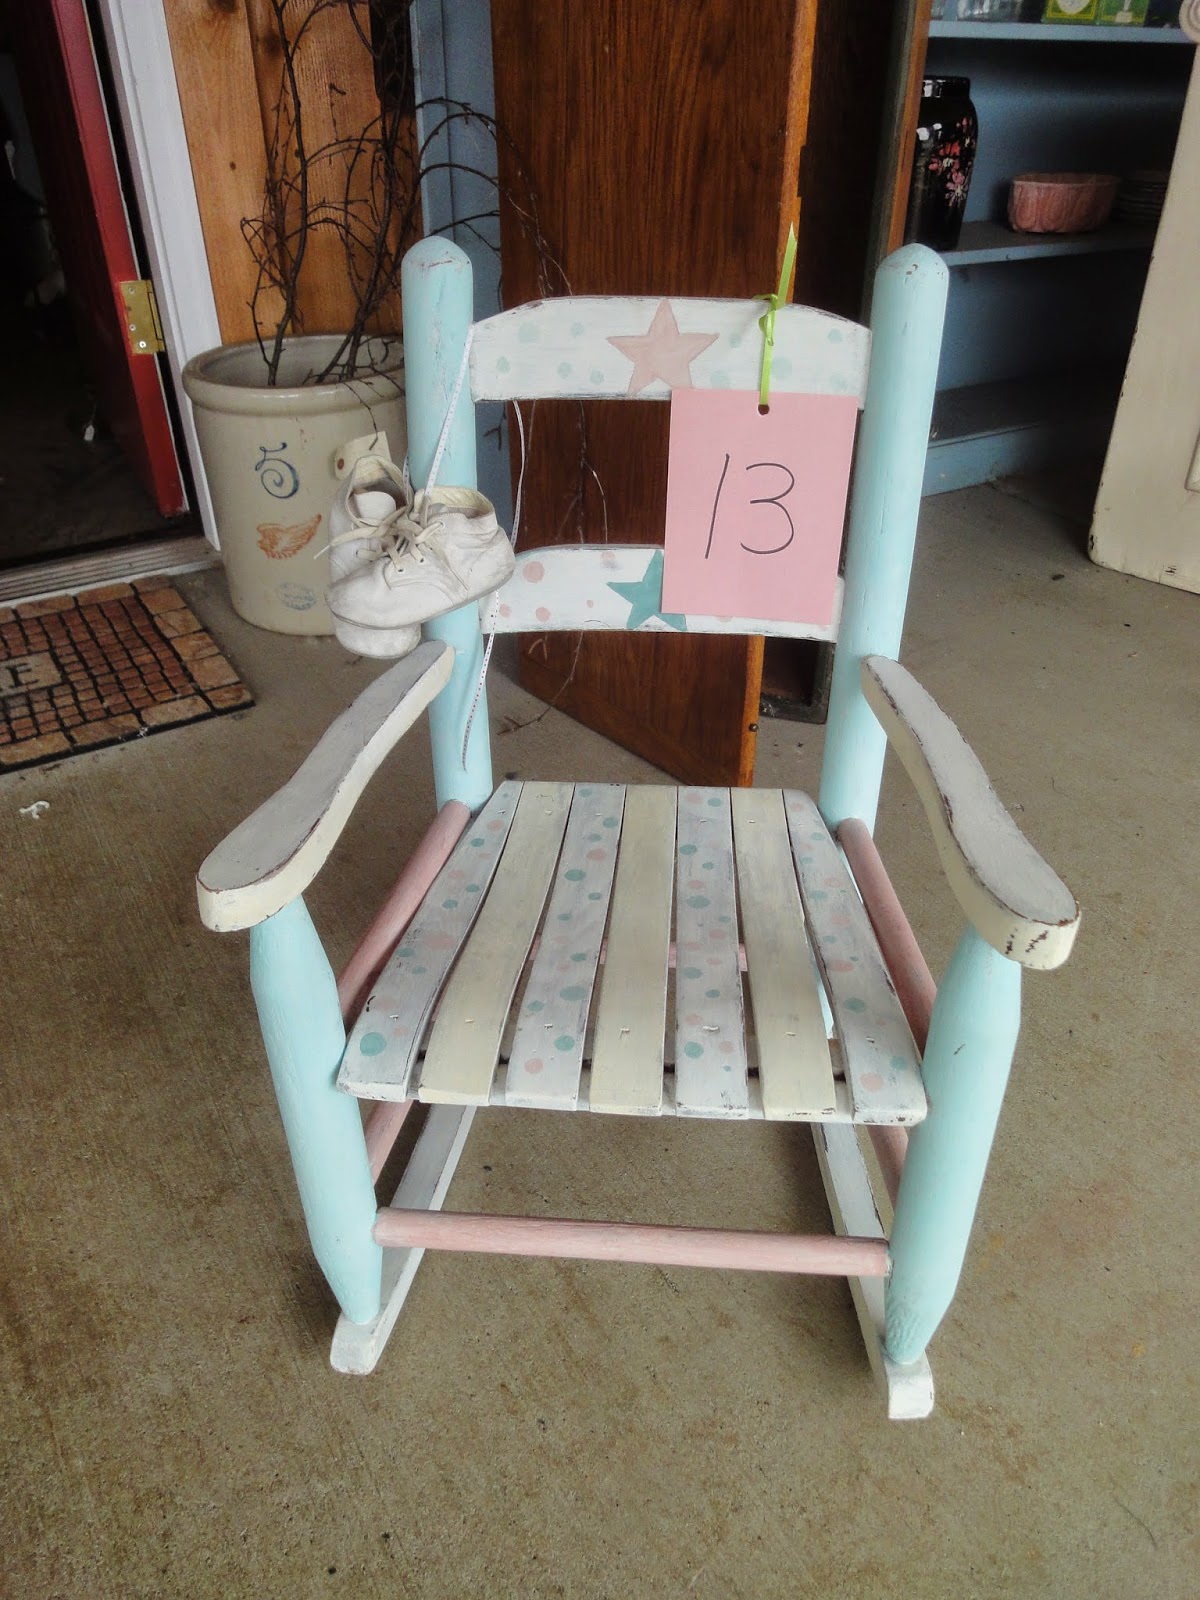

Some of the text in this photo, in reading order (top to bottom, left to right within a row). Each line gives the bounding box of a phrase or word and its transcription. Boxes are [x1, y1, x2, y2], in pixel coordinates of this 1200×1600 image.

[255, 442, 299, 499] 5
[704, 453, 795, 559] 13
[0, 662, 40, 692] E
